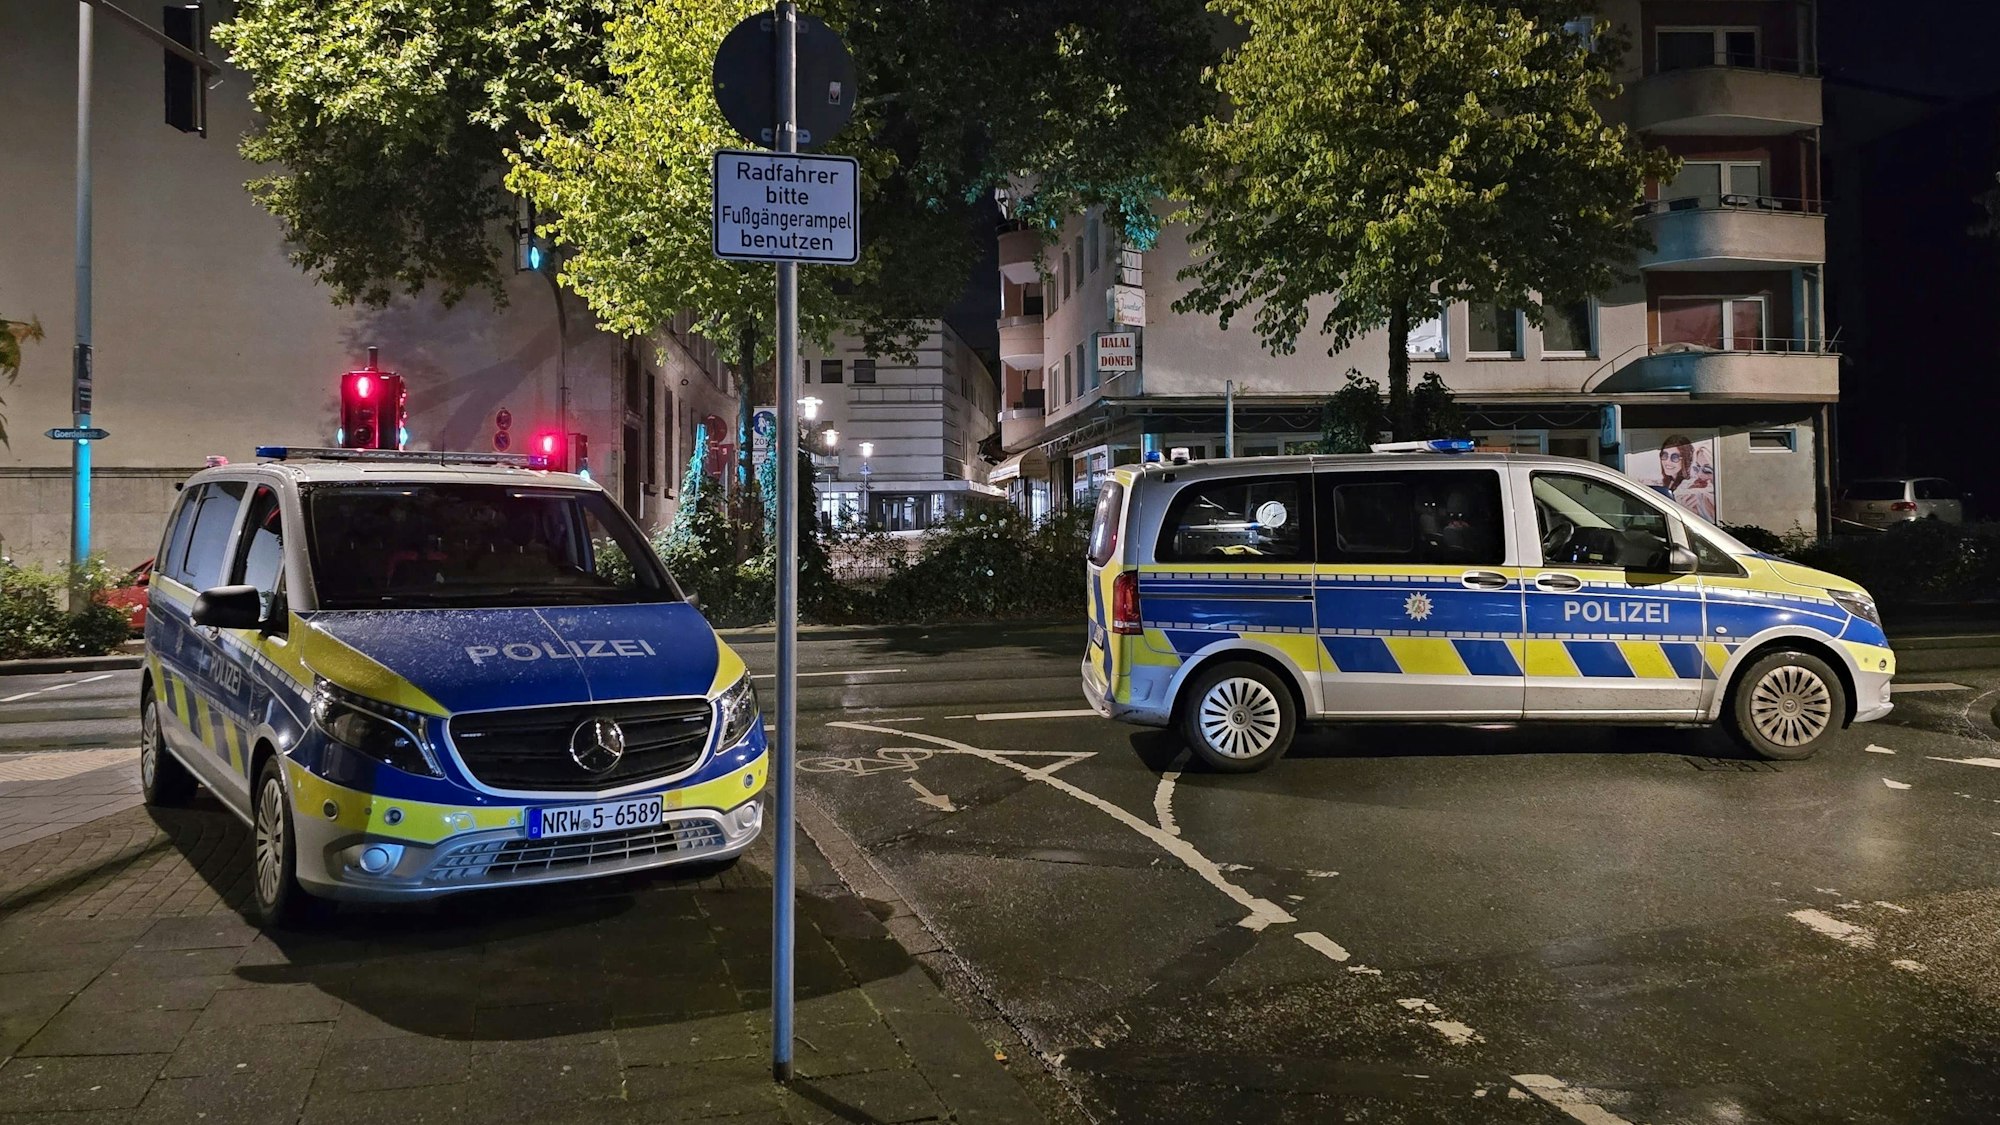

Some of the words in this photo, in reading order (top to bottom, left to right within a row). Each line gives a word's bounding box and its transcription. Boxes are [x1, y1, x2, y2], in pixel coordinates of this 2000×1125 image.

[737, 162, 839, 184] Radfahrer
[766, 186, 809, 205] bitte
[722, 206, 852, 233] Fußgängerampel
[741, 229, 833, 251] benutzen
[1101, 337, 1131, 348] HALAL
[1101, 353, 1133, 367] DÖNER
[1564, 600, 1670, 624] POLIZEI
[464, 639, 657, 665] POLIZEI
[209, 651, 242, 696] POLIZEI
[542, 809, 581, 834] NRW
[592, 801, 660, 829] 5-6589
